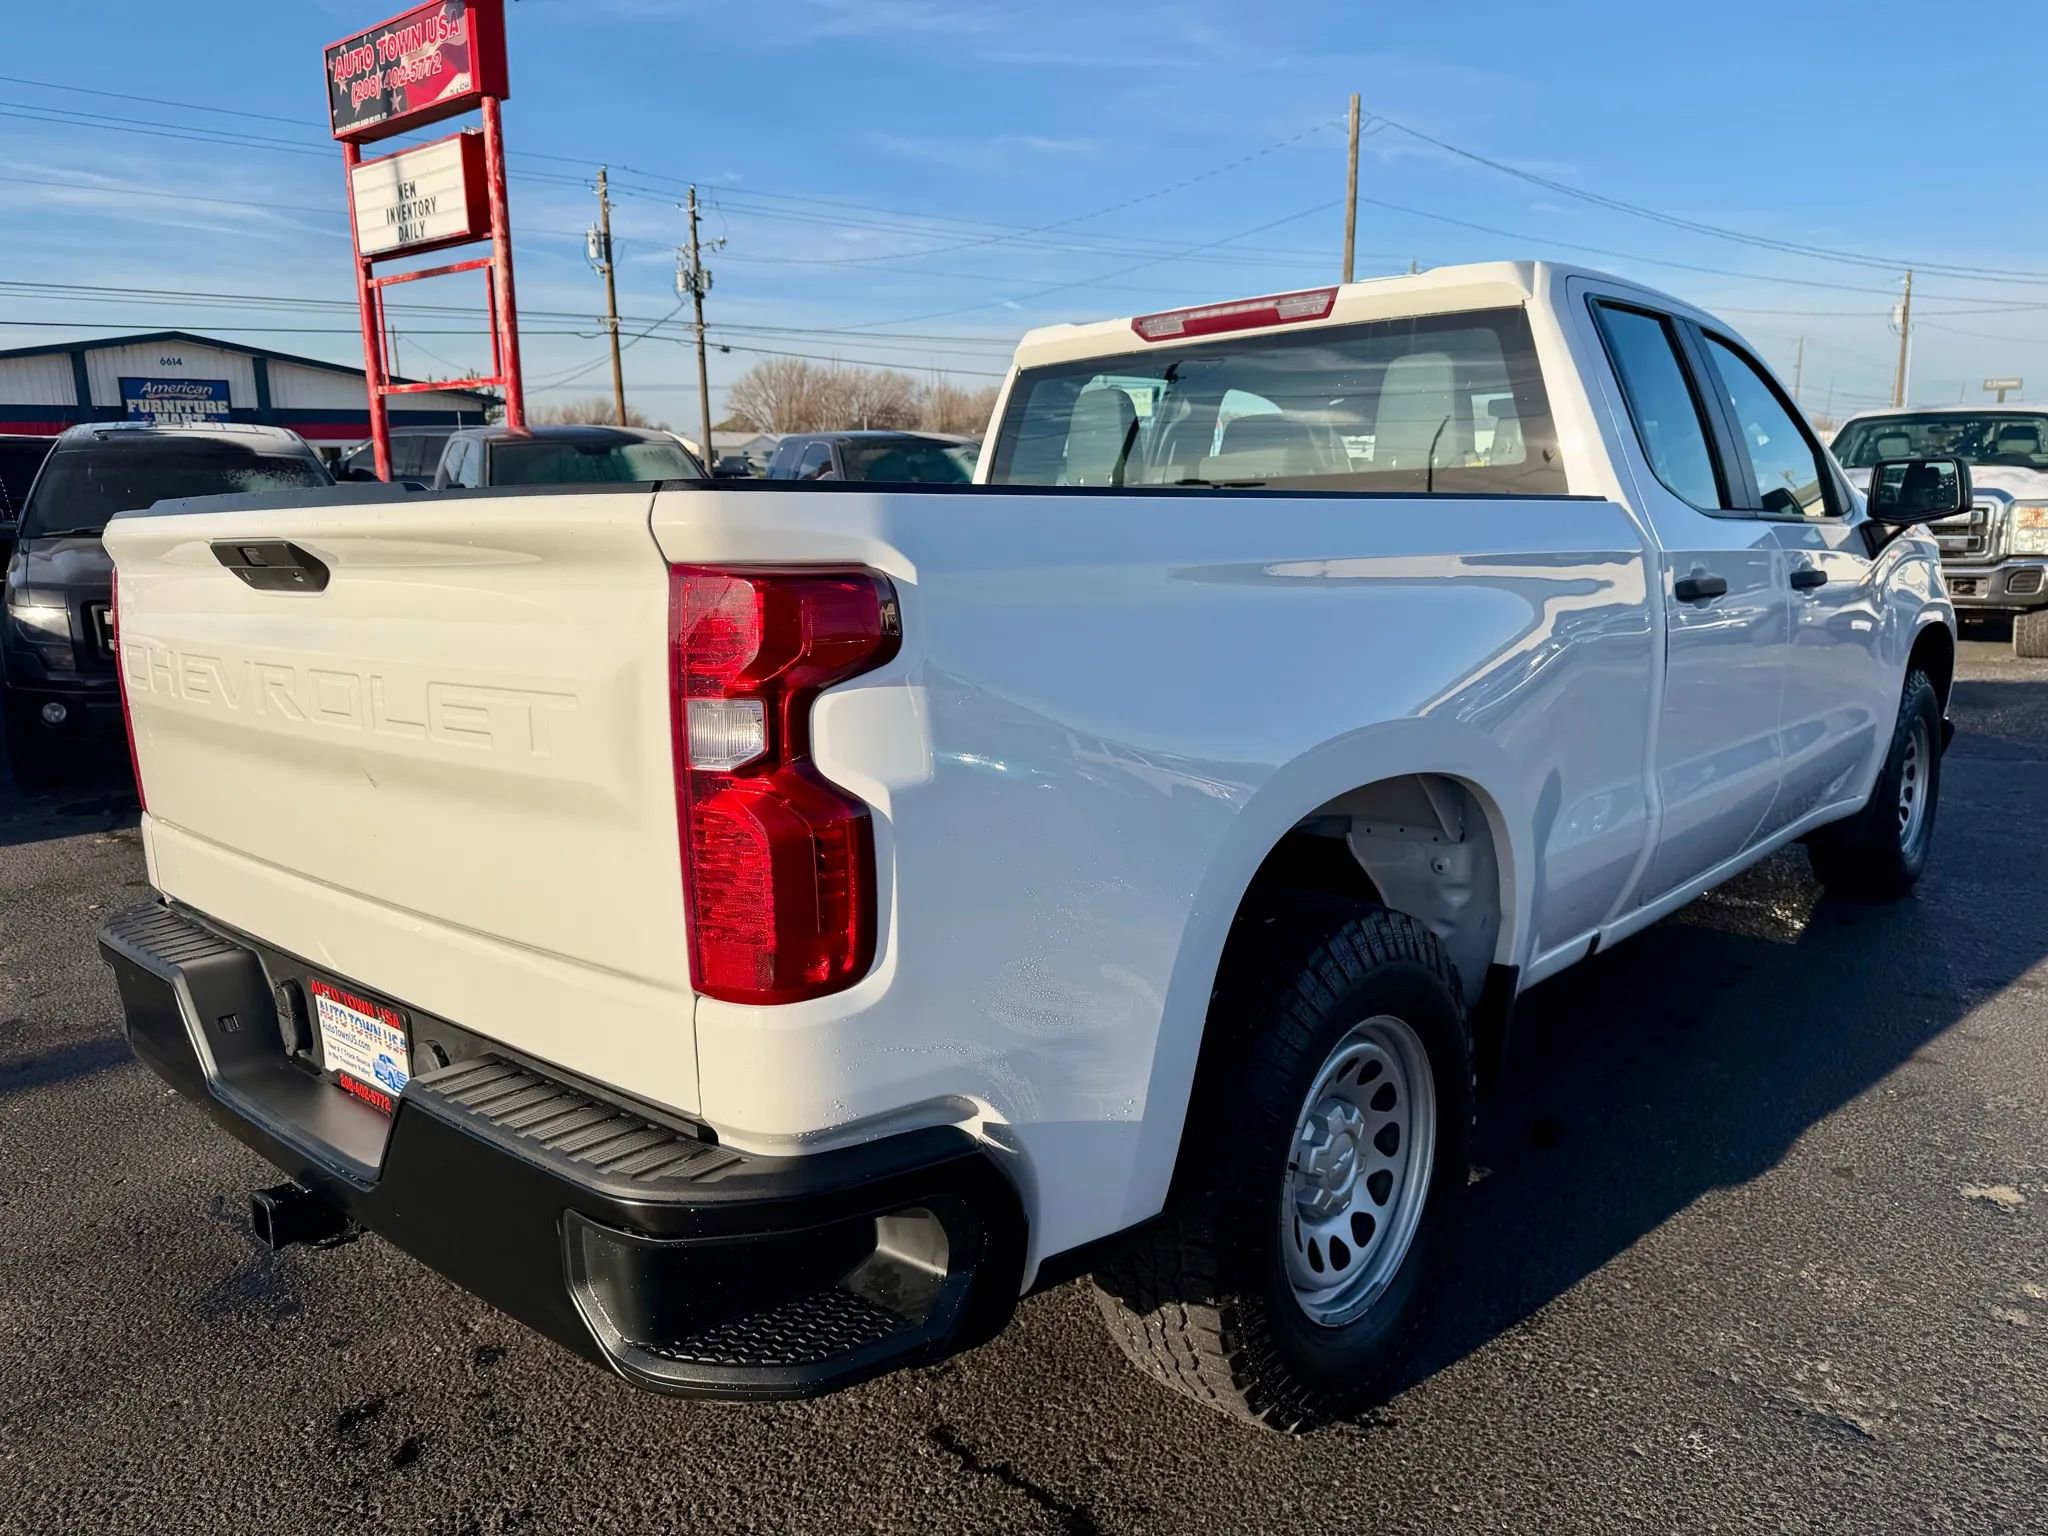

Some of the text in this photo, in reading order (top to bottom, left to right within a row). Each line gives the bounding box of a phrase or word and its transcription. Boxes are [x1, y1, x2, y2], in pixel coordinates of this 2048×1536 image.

[334, 9, 460, 82] AUTO TOWN USA
[351, 51, 442, 108] (208) 402-5772
[398, 181, 416, 201] NEW
[386, 197, 437, 225] INVENTORY
[398, 221, 425, 242] DAILY
[160, 358, 182, 366] 6614
[140, 382, 212, 395] American
[126, 400, 229, 414] FURNITURE
[154, 413, 205, 423] MART
[122, 635, 579, 758] CHEVROLET
[311, 979, 400, 1028] AUTO TOWN USA
[319, 1000, 348, 1028] AUTO
[350, 1012, 382, 1046] TOWN
[322, 1022, 371, 1052] AutoTownUS.com
[340, 1073, 391, 1112] 208-402-5772
